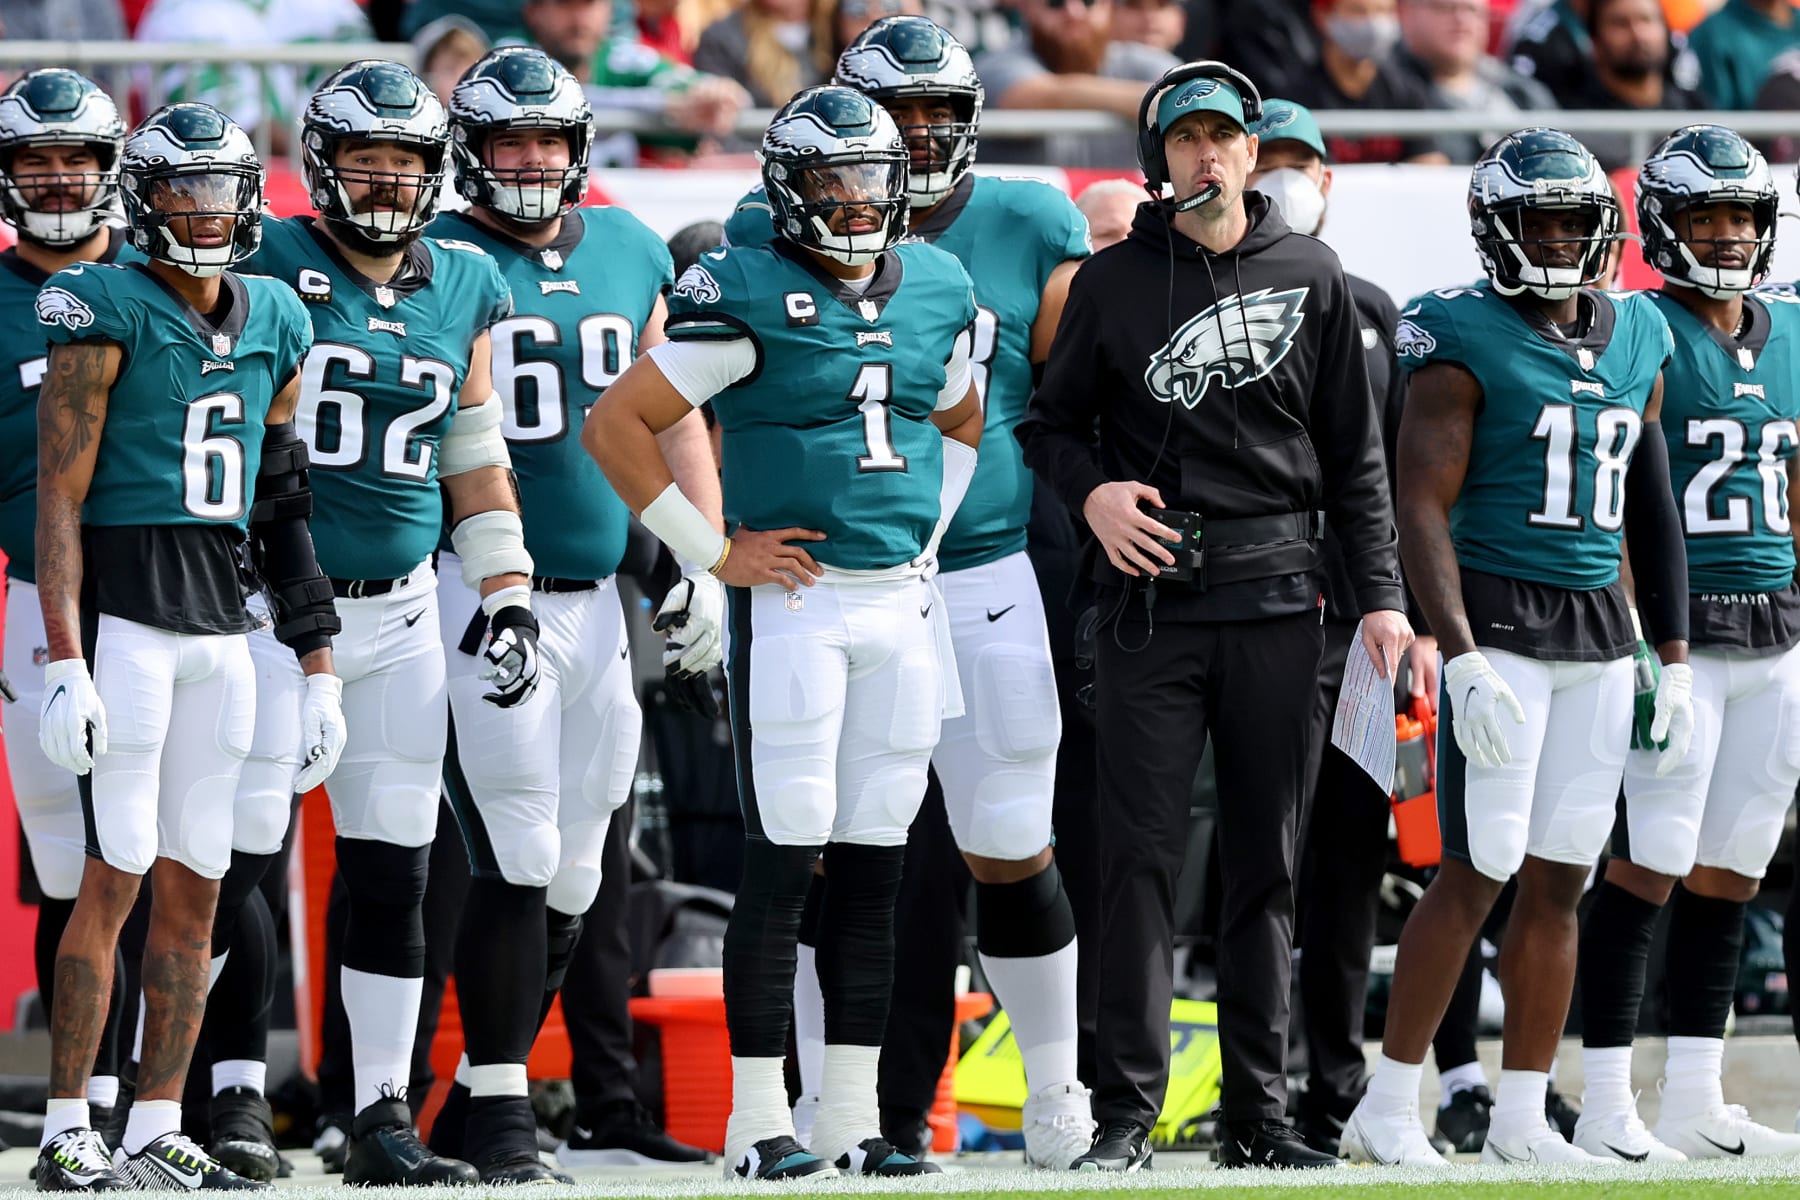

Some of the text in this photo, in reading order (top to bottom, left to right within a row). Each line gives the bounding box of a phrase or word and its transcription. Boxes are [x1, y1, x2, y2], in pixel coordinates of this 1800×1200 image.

[299, 269, 331, 294] C
[367, 316, 406, 337] EAGLES
[785, 293, 816, 318] C
[855, 331, 893, 346] EAGLES
[182, 391, 246, 521] 6
[294, 341, 457, 483] 62
[846, 362, 908, 473] 1
[1528, 403, 1643, 532] 18
[1683, 417, 1799, 538] 26
